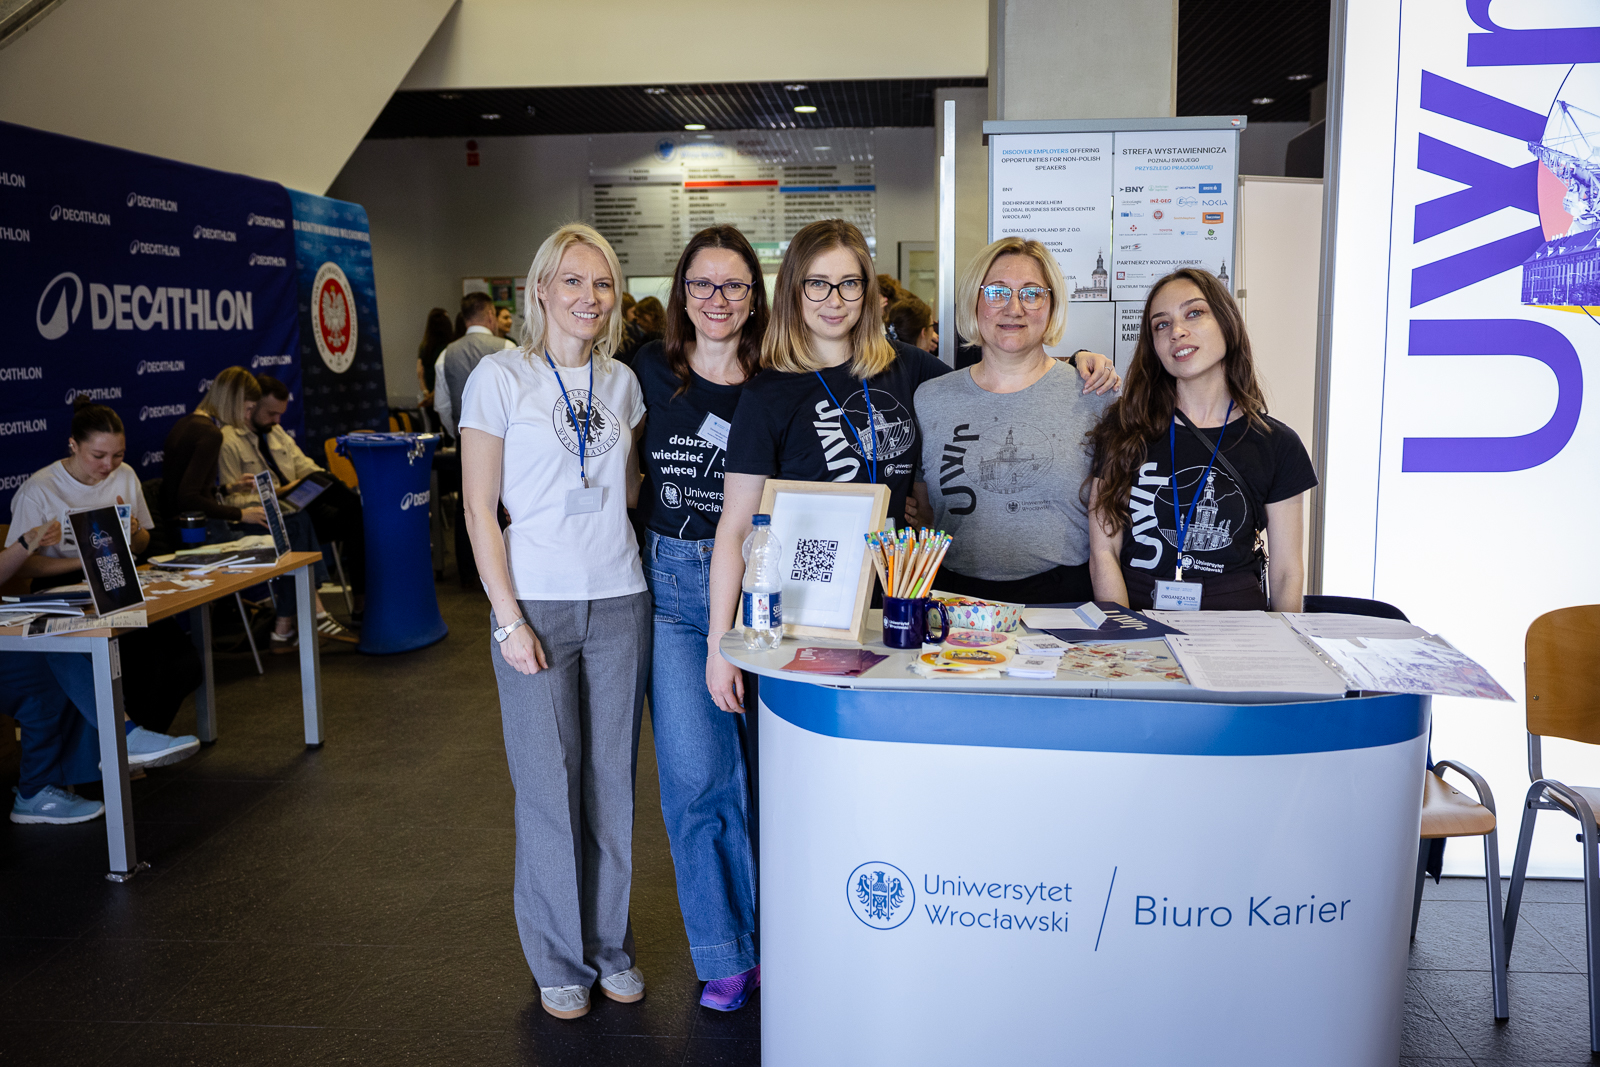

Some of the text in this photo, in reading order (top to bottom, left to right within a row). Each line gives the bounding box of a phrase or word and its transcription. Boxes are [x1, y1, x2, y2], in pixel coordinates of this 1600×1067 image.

[137, 194, 178, 213] DECATHLON
[62, 208, 111, 226] DECATHLON
[254, 215, 285, 229] DECATHLON
[201, 227, 237, 243] DECATHLON
[140, 242, 181, 257] DECATHLON
[256, 255, 287, 267] DECATHLON
[89, 283, 253, 331] DECATHLON
[146, 360, 185, 373] DECATHLON
[149, 404, 187, 418] DECATHLON
[557, 422, 620, 456] WRATILAVIENSIS
[669, 434, 714, 449] dobrze
[652, 449, 704, 463] wiedzieć
[660, 464, 697, 478] więcej
[940, 423, 980, 516] UWr
[1129, 462, 1169, 570] UWr
[924, 873, 1073, 906] Uniwersytet
[924, 903, 1069, 933] Wrocławski
[1135, 894, 1351, 928] Biuro Karier
